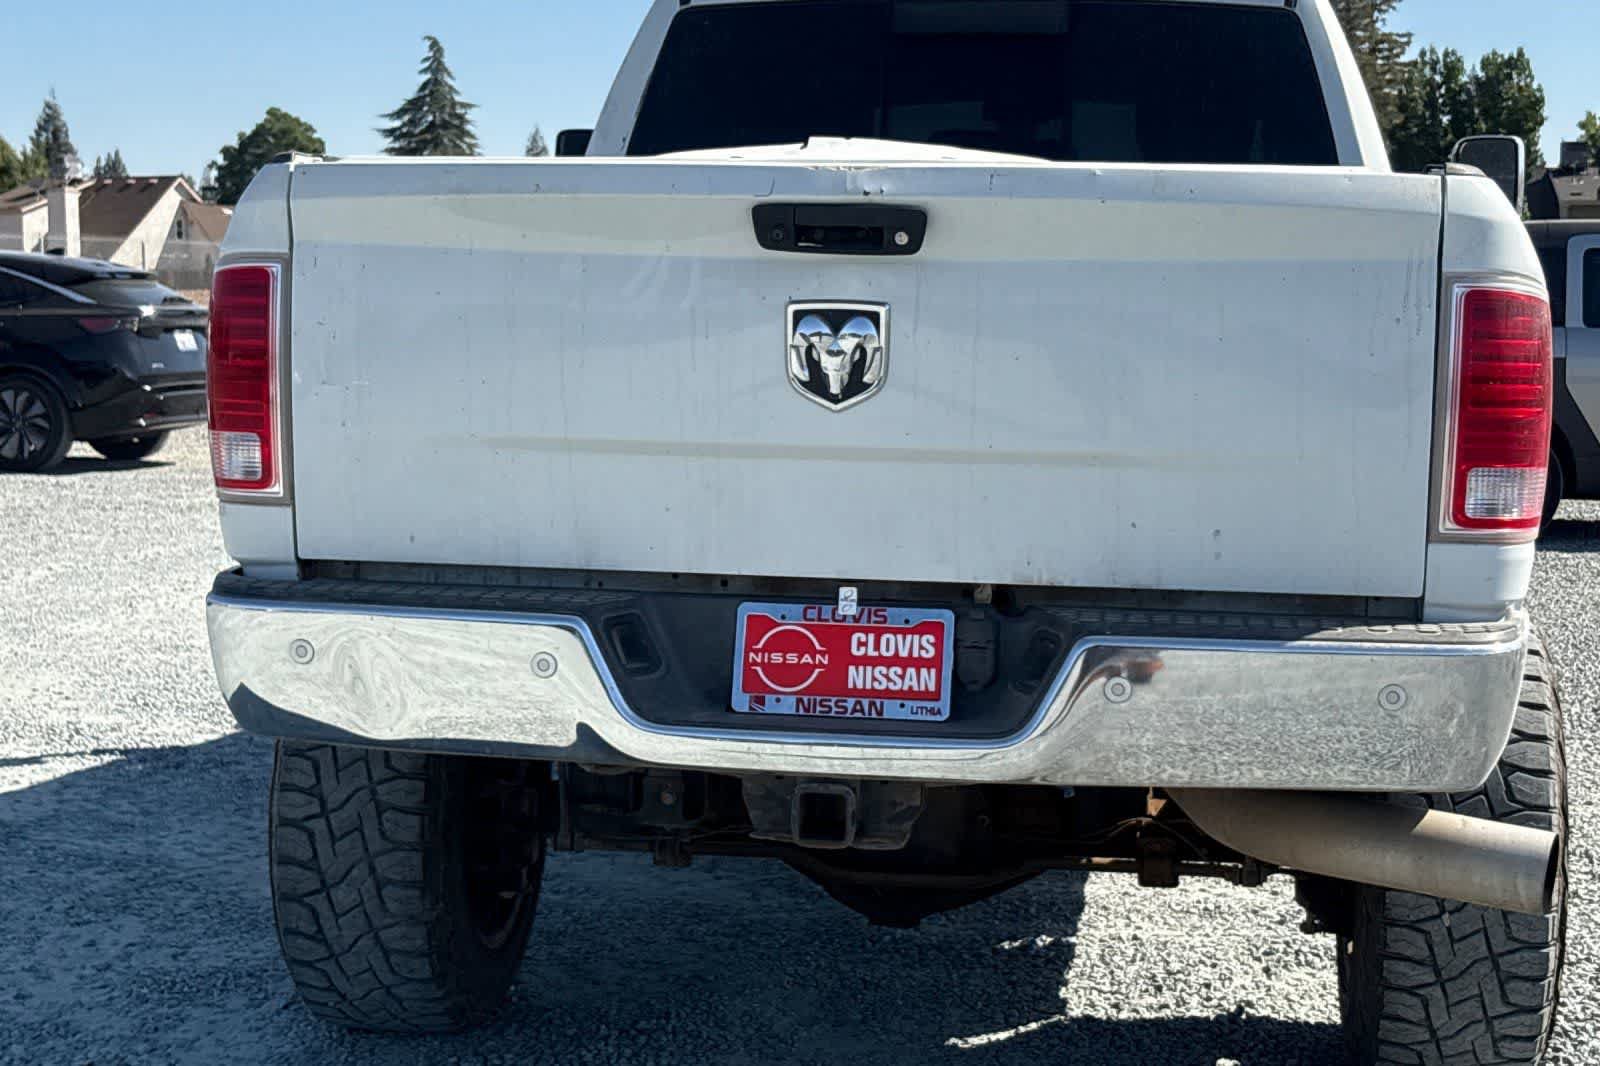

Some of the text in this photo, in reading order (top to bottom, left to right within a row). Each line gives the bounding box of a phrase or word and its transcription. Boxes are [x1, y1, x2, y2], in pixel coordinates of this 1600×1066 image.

[851, 632, 936, 658] CLOVIS
[749, 651, 829, 665] NISSAN
[847, 666, 936, 692] NISSAN
[795, 697, 884, 717] NISSAN
